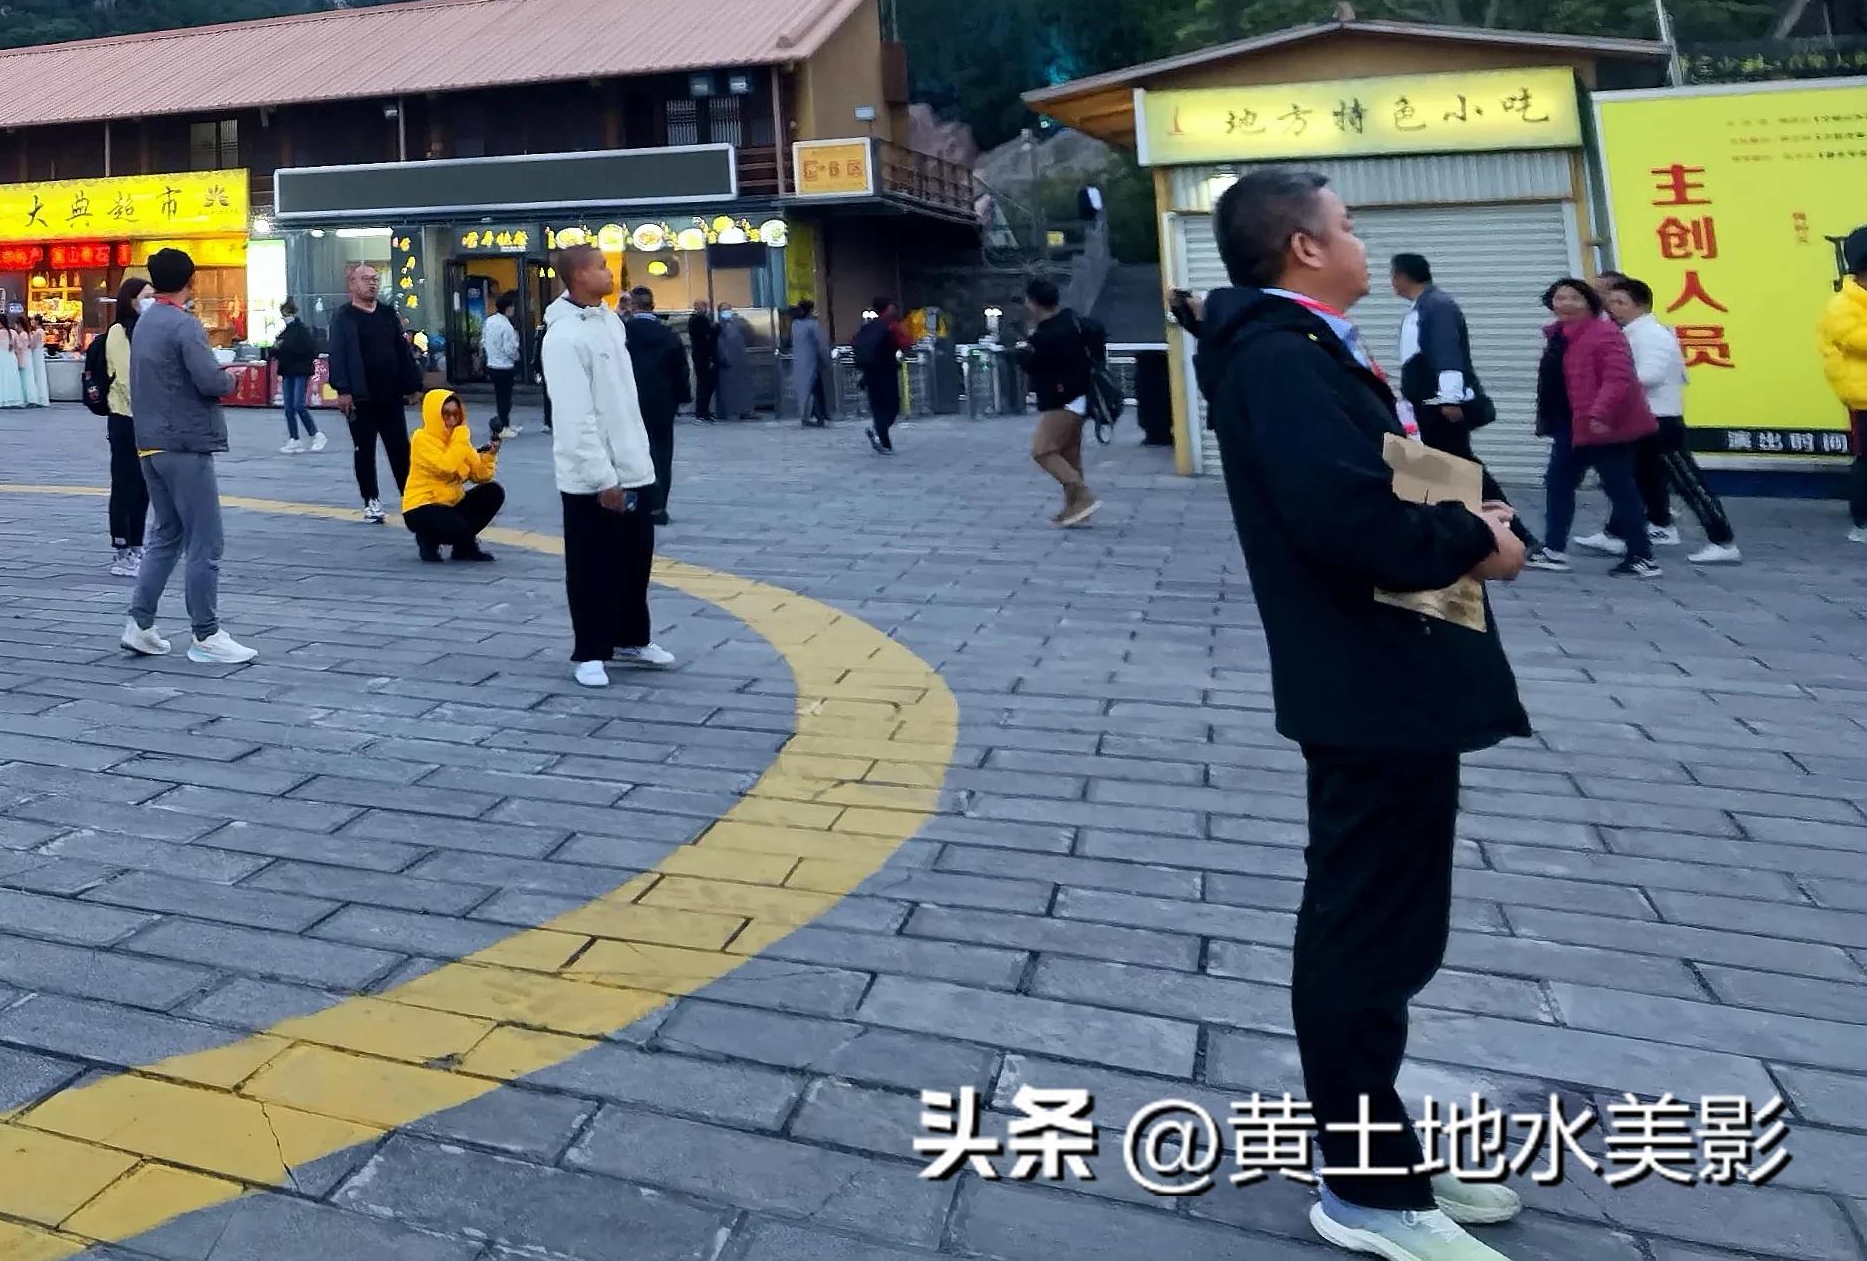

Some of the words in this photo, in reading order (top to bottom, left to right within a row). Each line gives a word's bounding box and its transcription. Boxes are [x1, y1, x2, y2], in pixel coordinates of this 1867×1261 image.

[1226, 87, 1549, 136] 地方特色小吃
[25, 185, 182, 229] 大典超市
[1651, 164, 1735, 368] 主创人员
